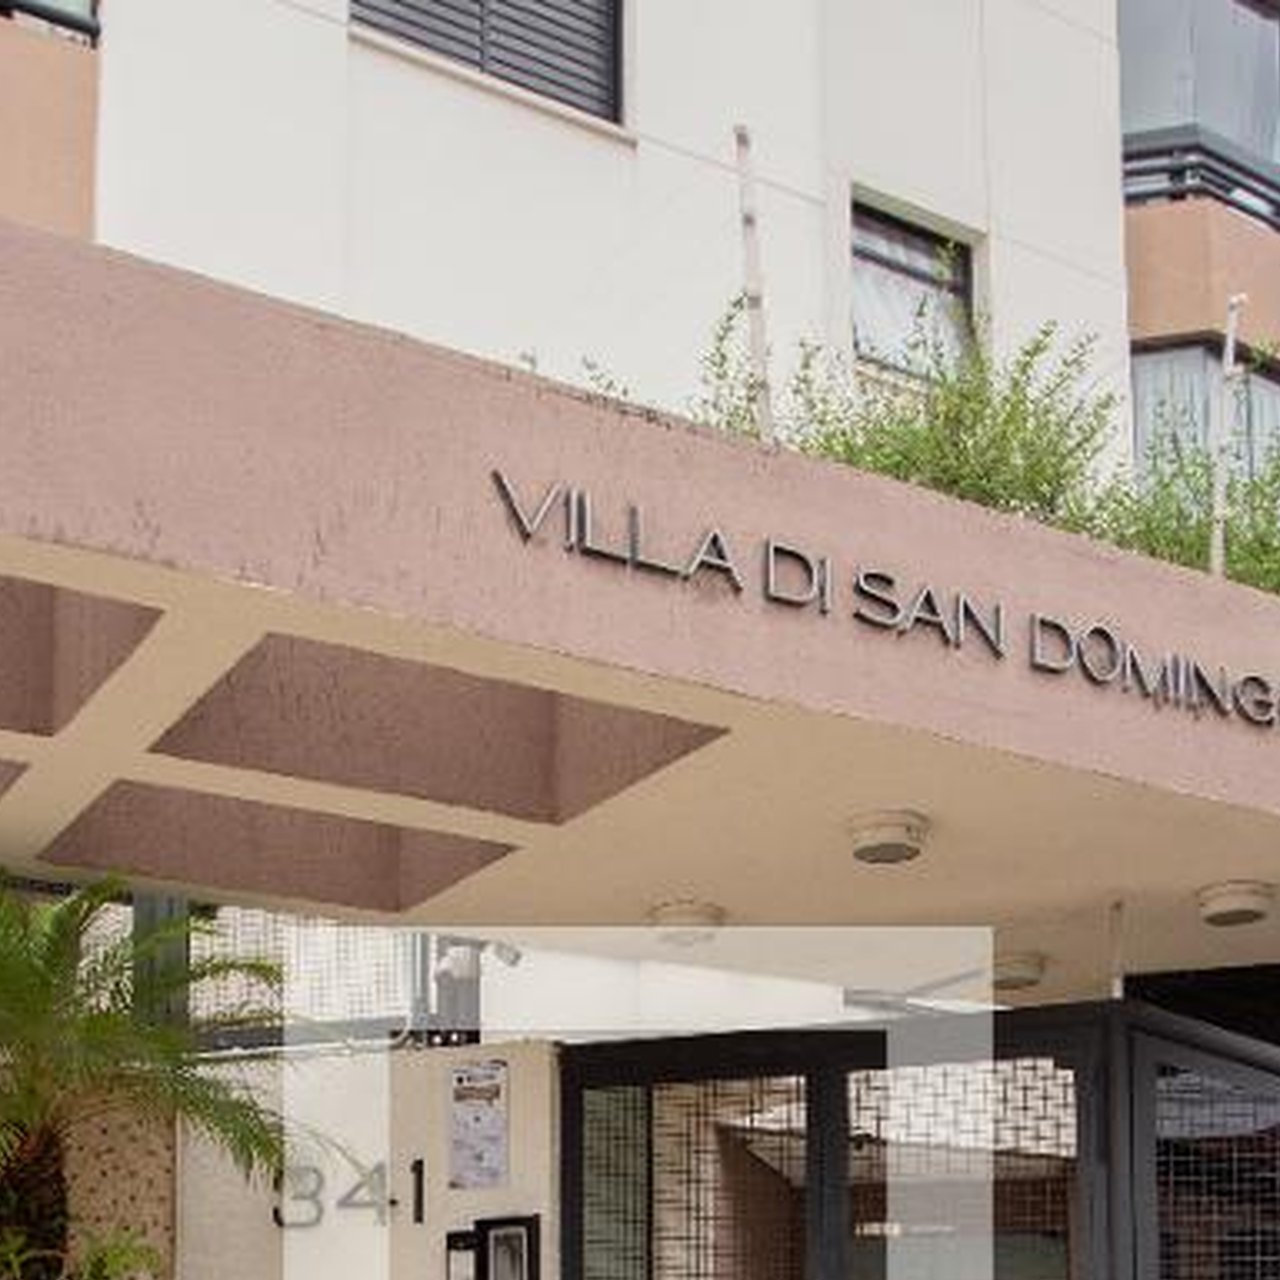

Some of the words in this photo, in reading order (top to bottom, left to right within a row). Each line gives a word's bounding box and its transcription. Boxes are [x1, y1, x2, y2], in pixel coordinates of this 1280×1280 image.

[492, 469, 743, 594] VILLA
[764, 534, 832, 615] DI
[854, 562, 1006, 661] SAN
[273, 1159, 424, 1228] 341
